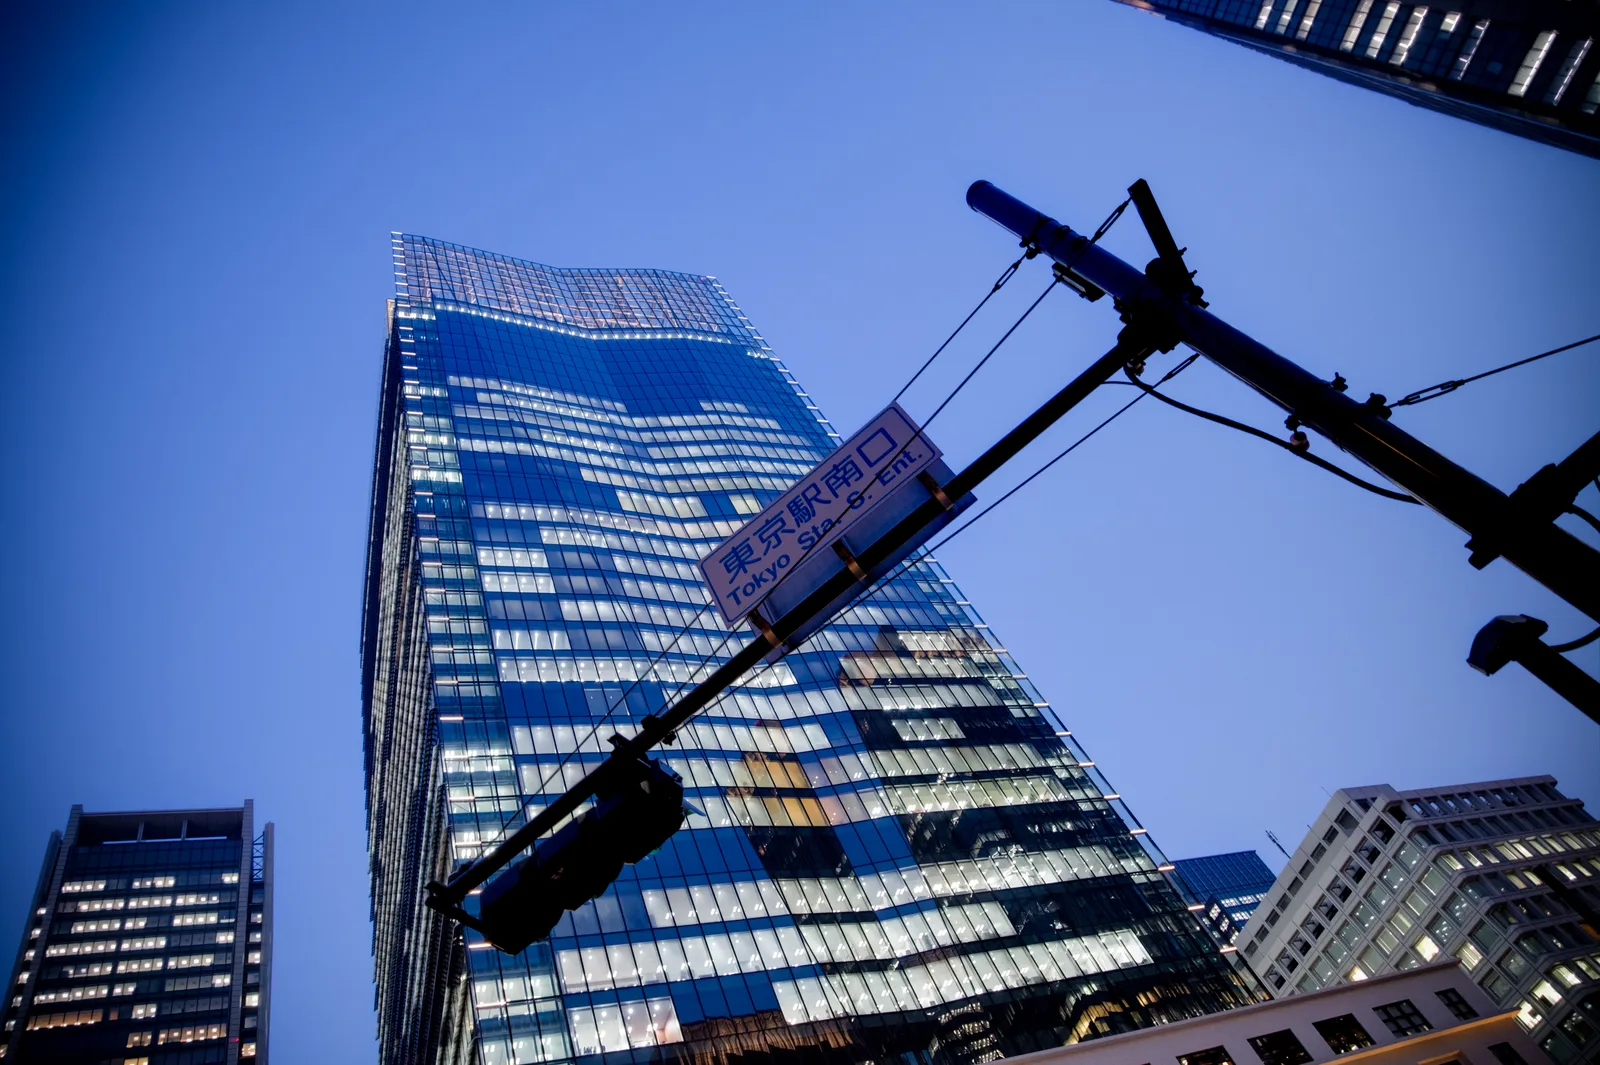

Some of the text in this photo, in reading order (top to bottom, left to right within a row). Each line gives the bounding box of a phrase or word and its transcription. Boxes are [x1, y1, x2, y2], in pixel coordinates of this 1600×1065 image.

[719, 427, 898, 585] 東京駅南口
[726, 449, 923, 606] Tokyo Sta. S. Ent.
